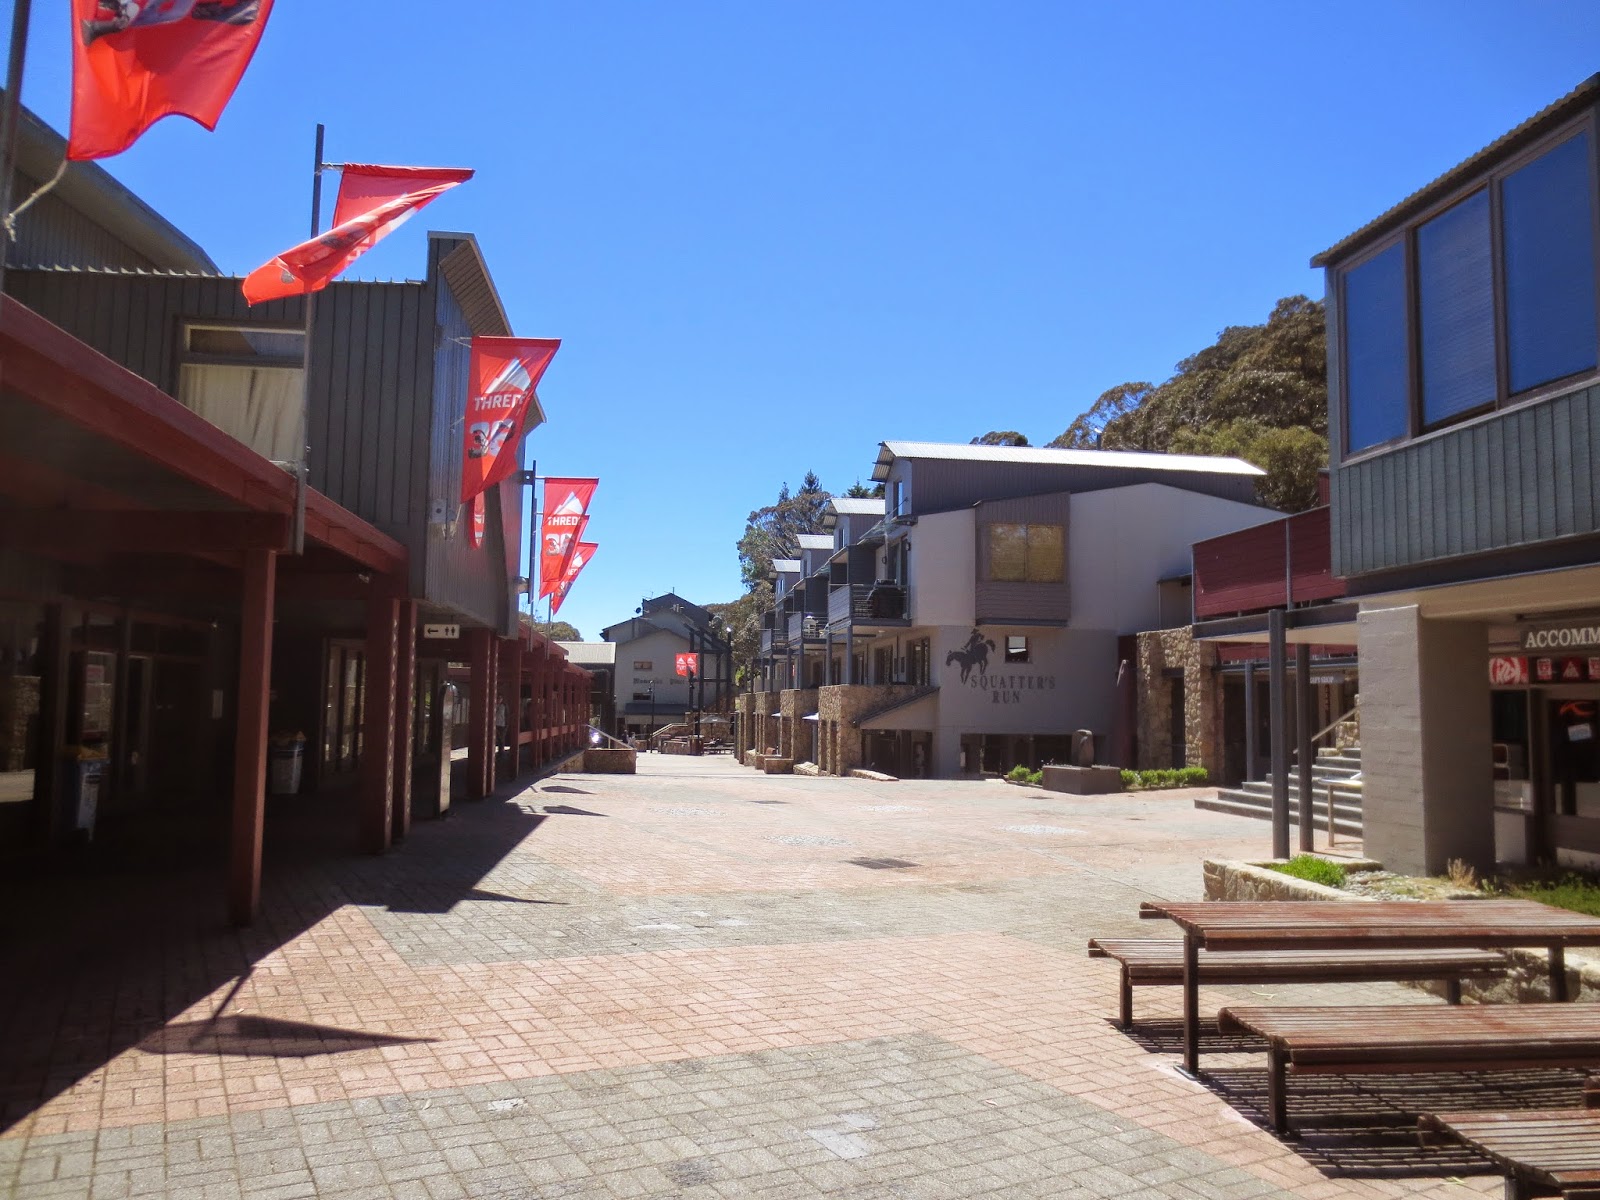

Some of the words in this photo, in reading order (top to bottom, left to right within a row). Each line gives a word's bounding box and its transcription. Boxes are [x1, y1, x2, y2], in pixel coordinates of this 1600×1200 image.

[548, 516, 581, 526] THRED
[1525, 627, 1600, 649] ACCOMM
[971, 675, 1056, 690] SQUATTER'S
[992, 690, 1020, 704] RUN
